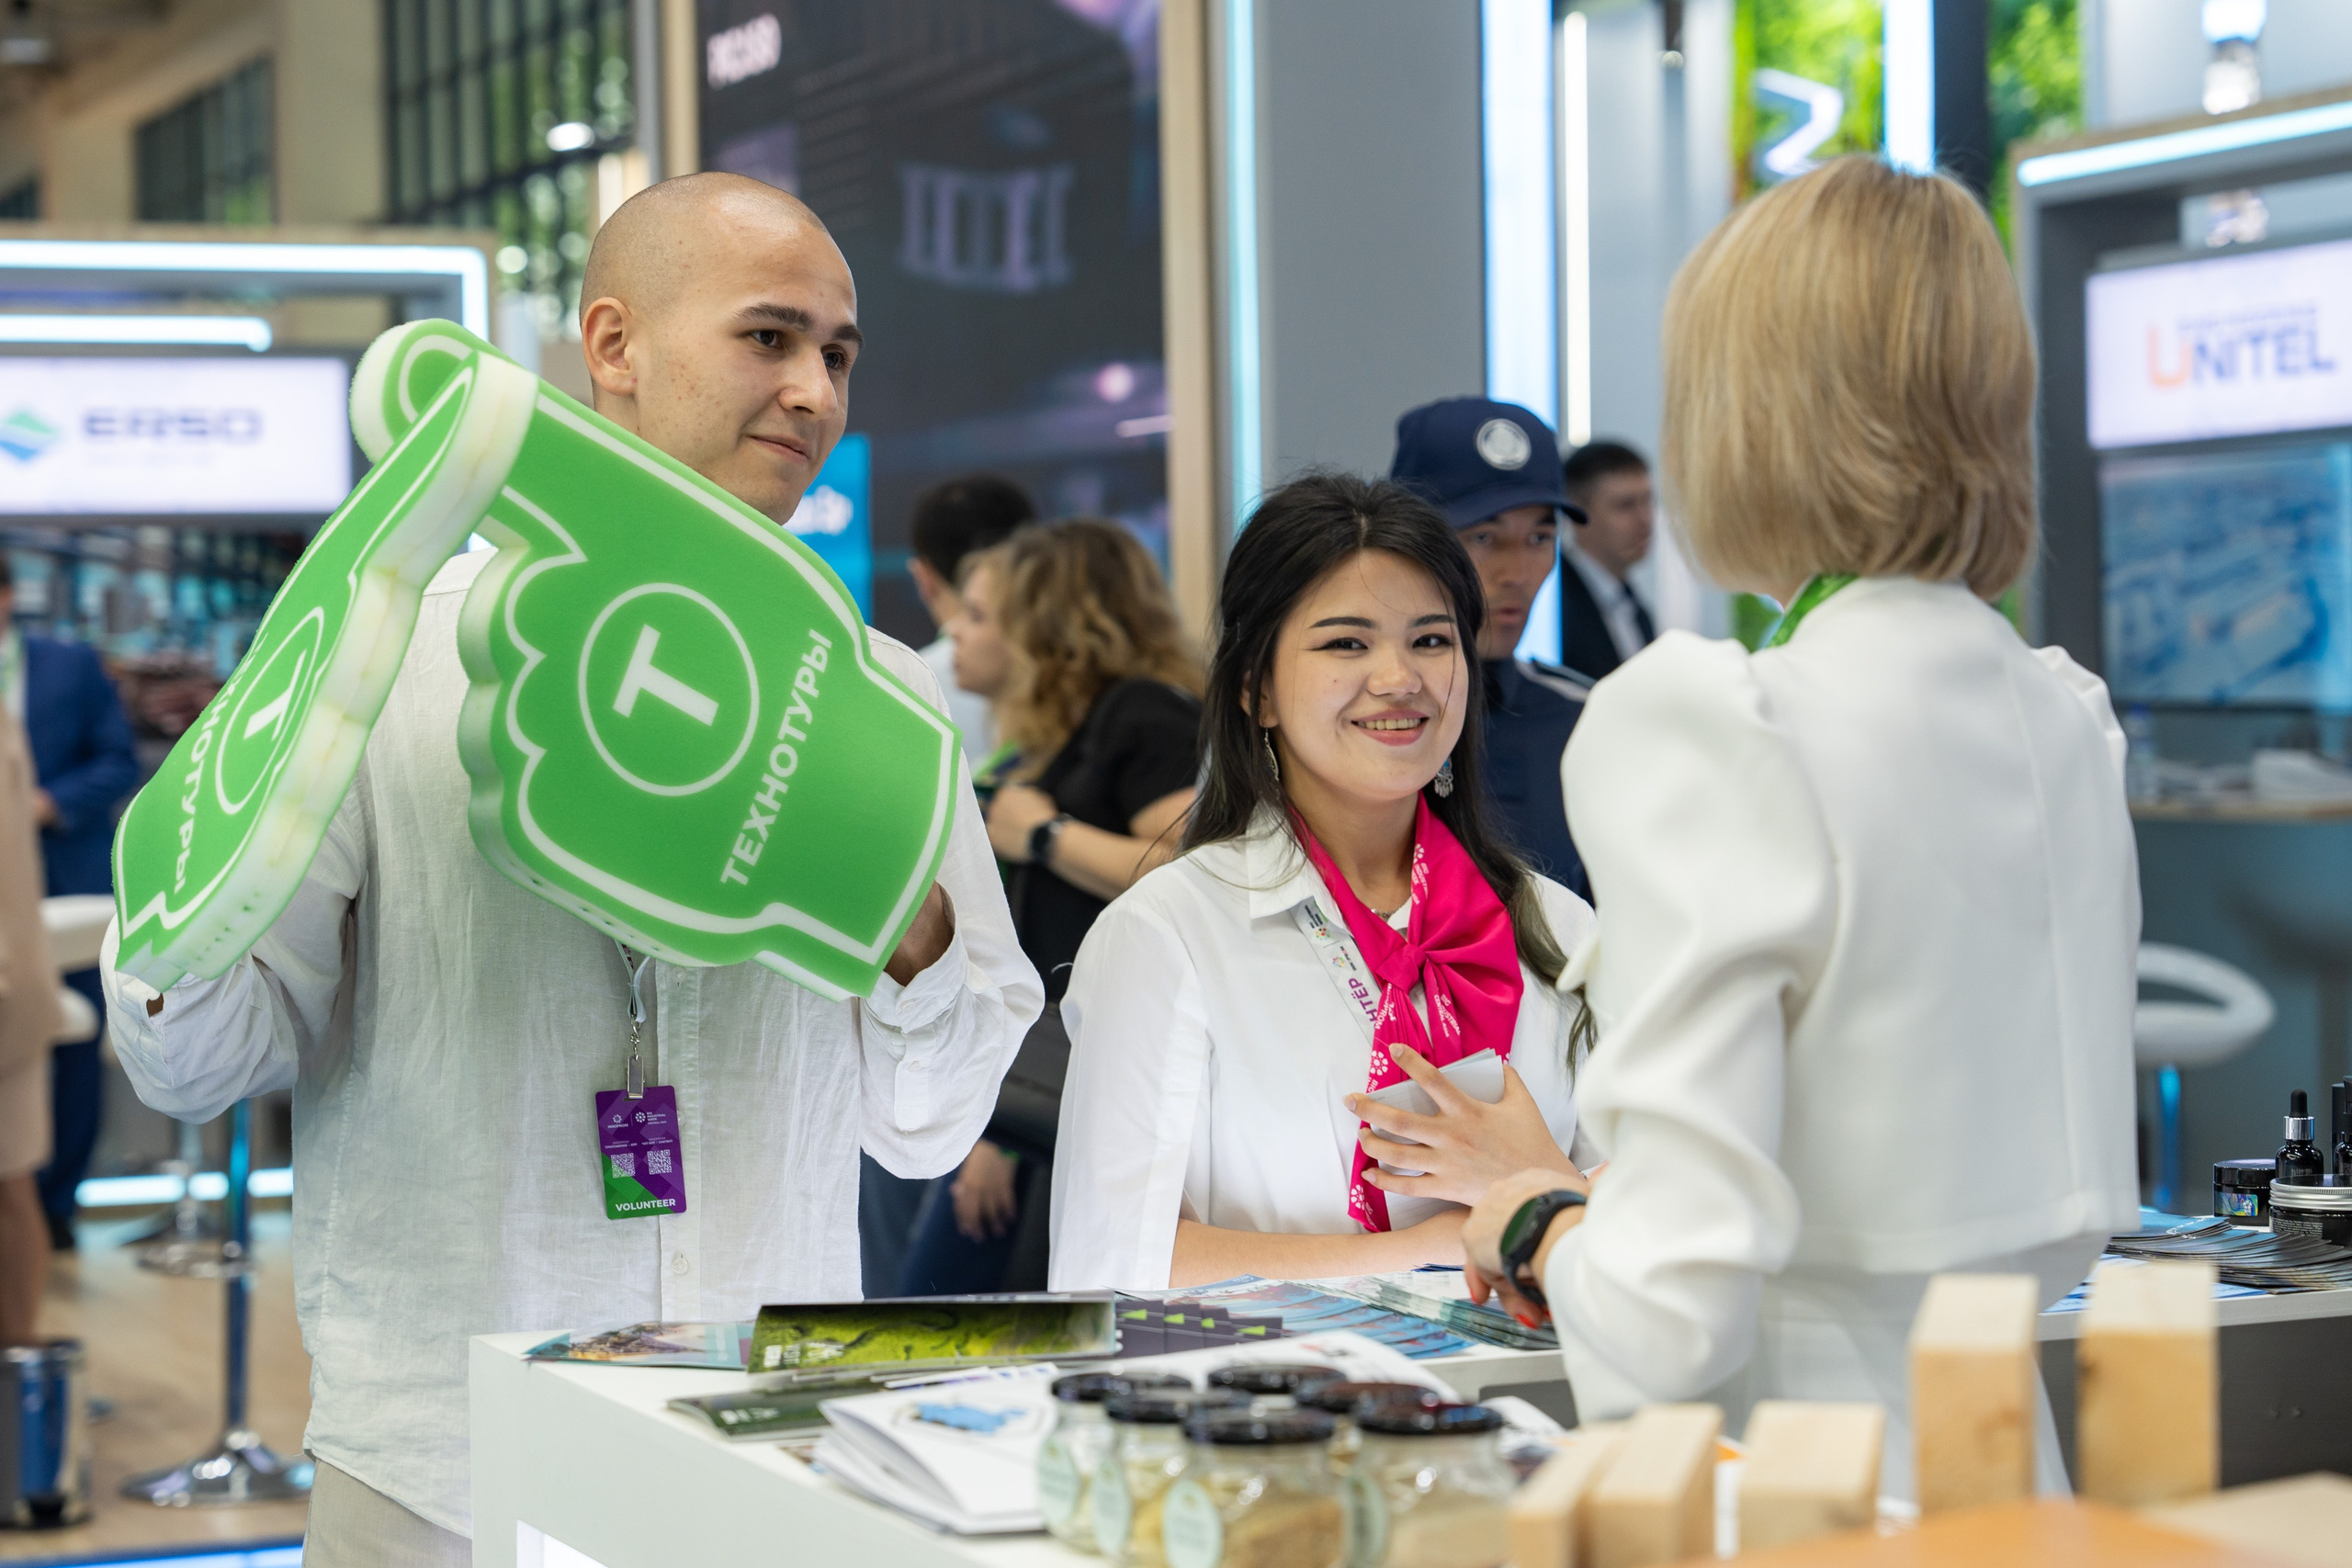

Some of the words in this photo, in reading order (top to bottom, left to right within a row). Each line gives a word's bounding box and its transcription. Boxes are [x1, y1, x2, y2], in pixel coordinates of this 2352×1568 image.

[719, 628, 832, 887] ТЕХНОТУРЫ
[1348, 977, 1378, 1022] НТЁР
[1441, 993, 1452, 1007] BIG
[1441, 1004, 1461, 1036] DUSTRIAL
[615, 1198, 676, 1213] VOLUNTEER
